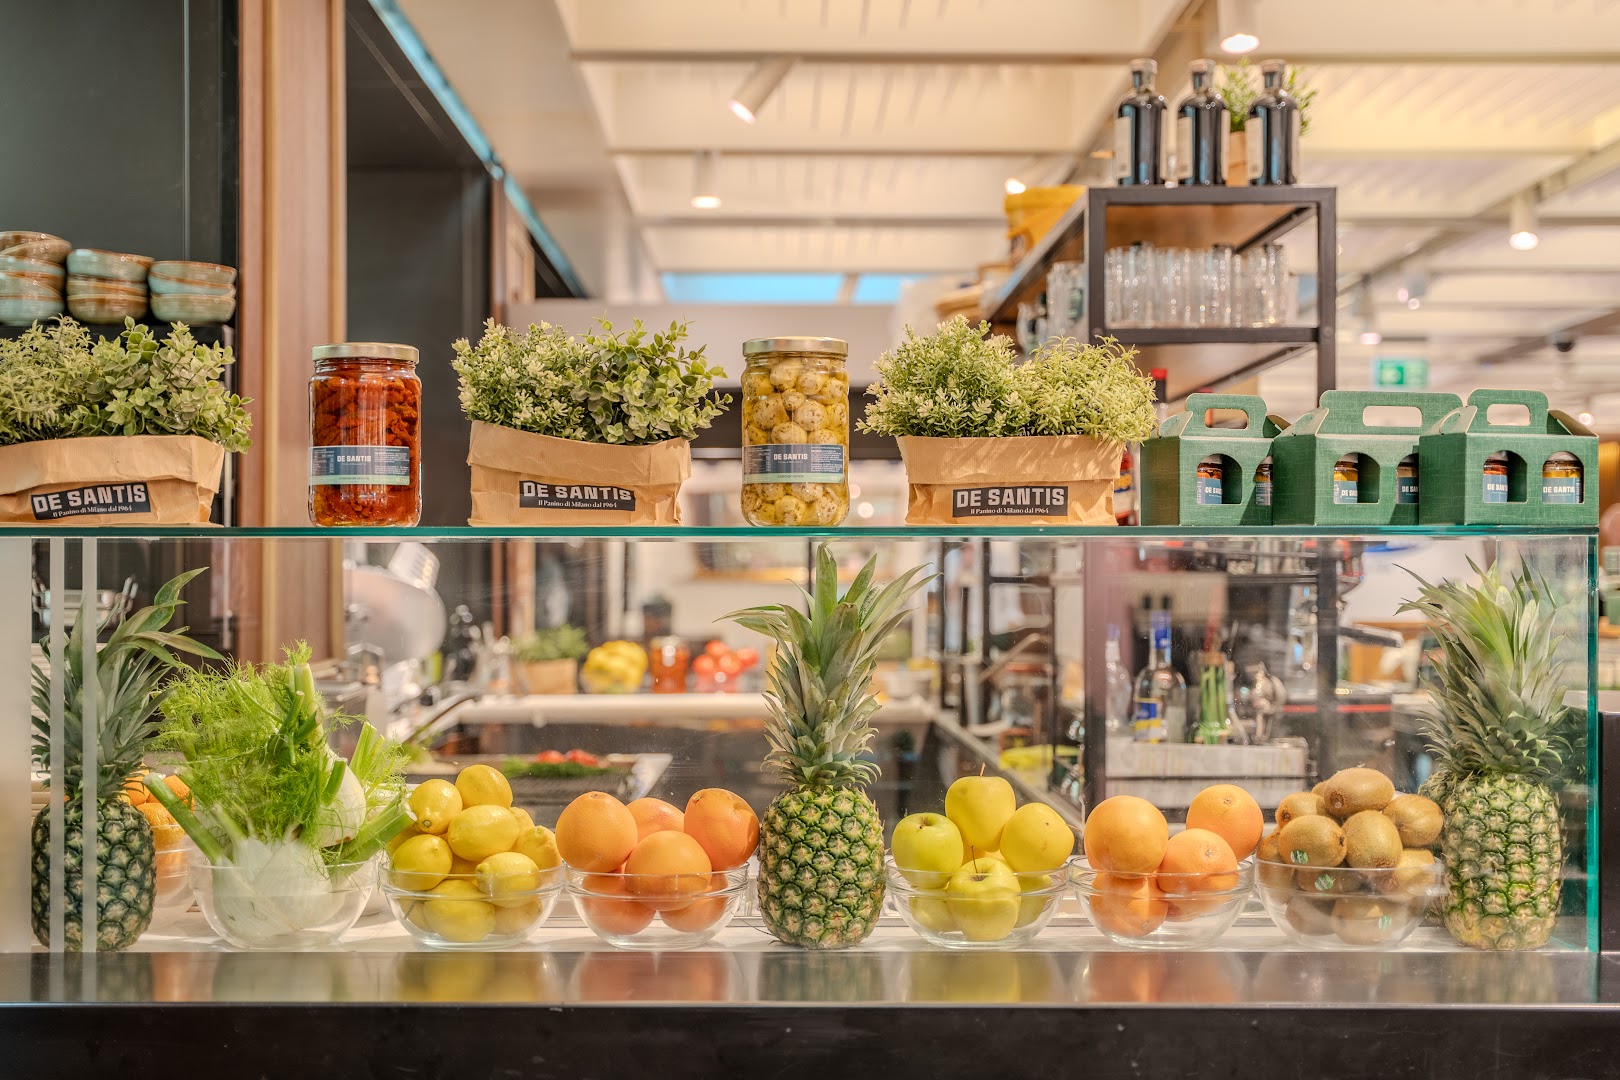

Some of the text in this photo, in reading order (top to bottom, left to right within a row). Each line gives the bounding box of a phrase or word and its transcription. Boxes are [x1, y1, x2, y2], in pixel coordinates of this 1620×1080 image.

[33, 485, 146, 513] DE SANTIS
[523, 482, 632, 501] DE SANTIS
[956, 487, 1065, 508] DE SANTIS
[58, 509, 80, 517] Panino
[118, 504, 133, 512] 1964
[543, 499, 564, 507] Panino
